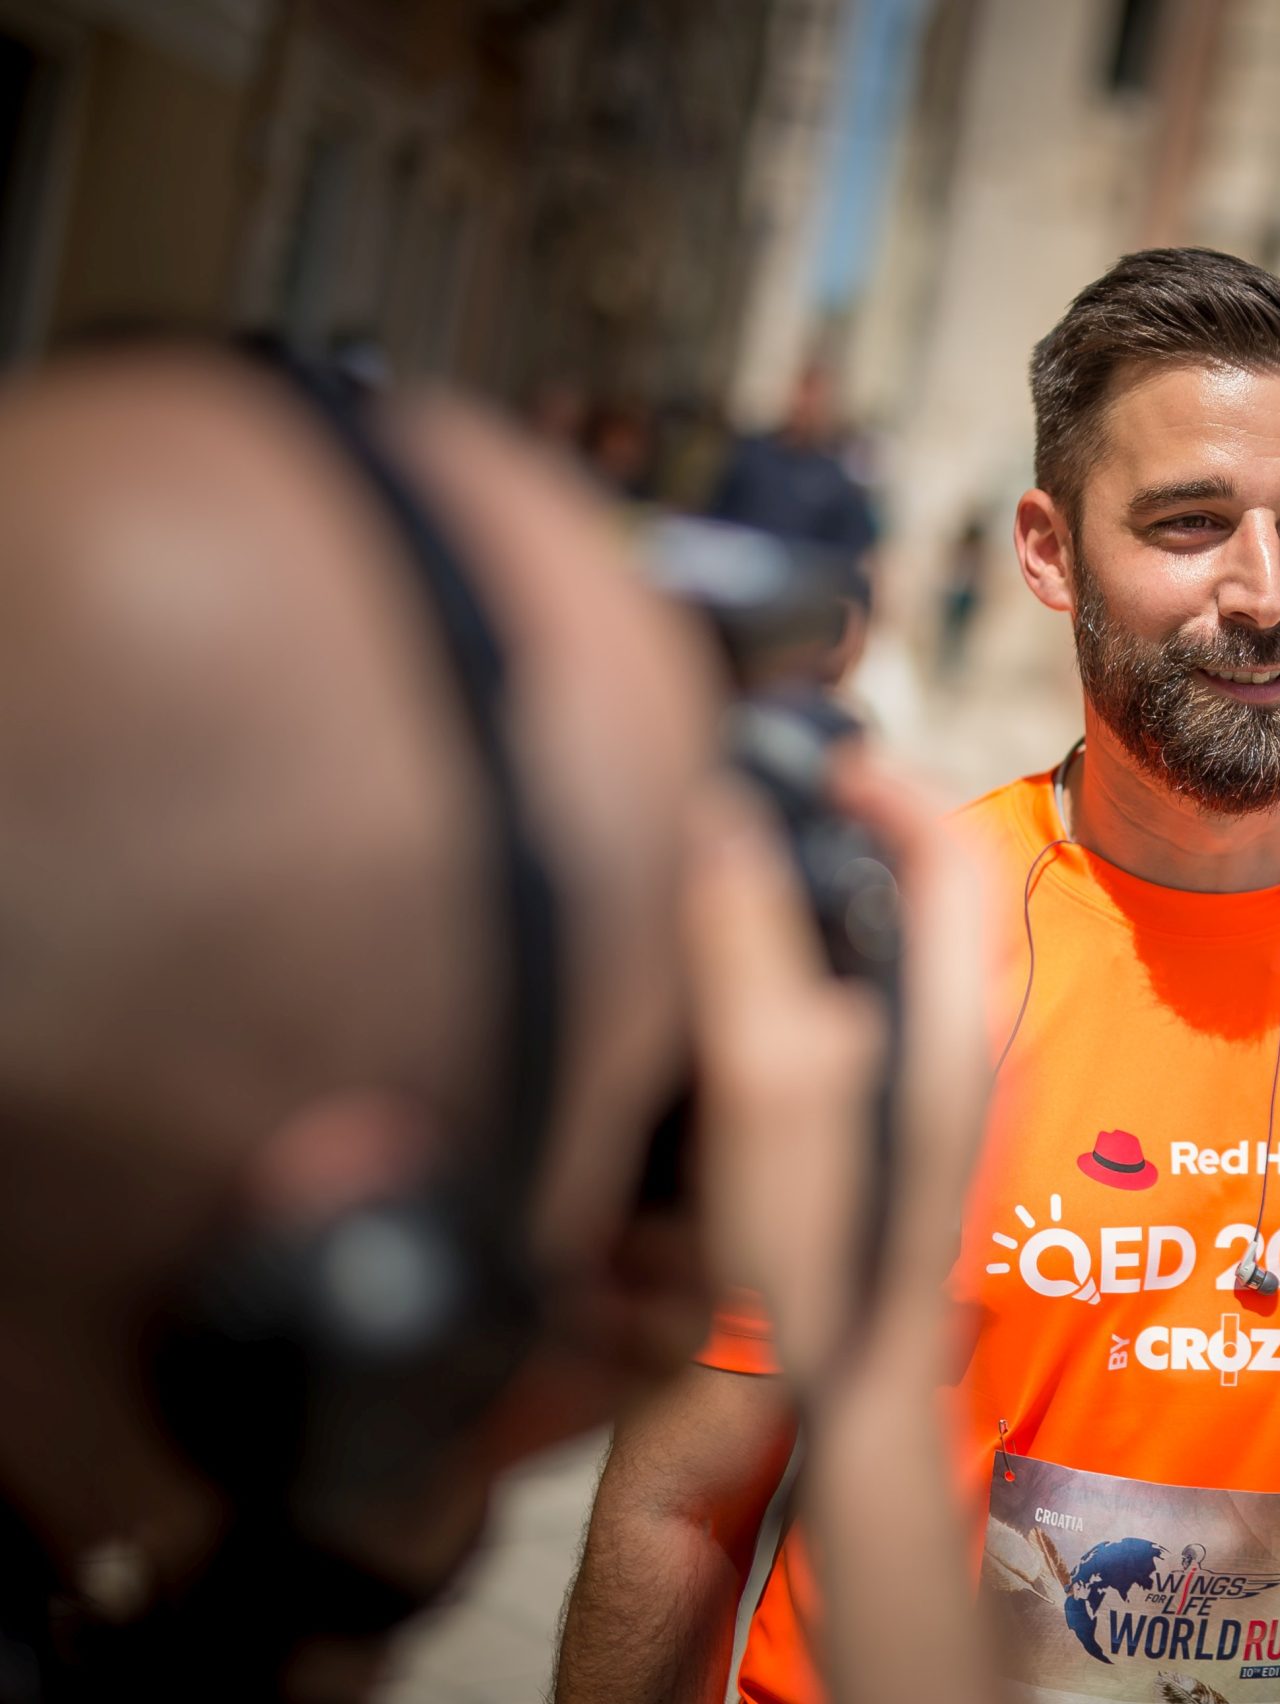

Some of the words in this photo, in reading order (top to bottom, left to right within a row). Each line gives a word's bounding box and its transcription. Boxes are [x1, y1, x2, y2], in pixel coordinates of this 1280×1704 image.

[1171, 1140, 1249, 1175] Red
[1019, 1225, 1197, 1304] QED
[1107, 1333, 1131, 1371] BY
[1035, 1507, 1083, 1532] CROATIA
[1145, 1593, 1166, 1604] FOR
[1162, 1595, 1217, 1616] LIFE
[1108, 1610, 1242, 1661] WORLD
